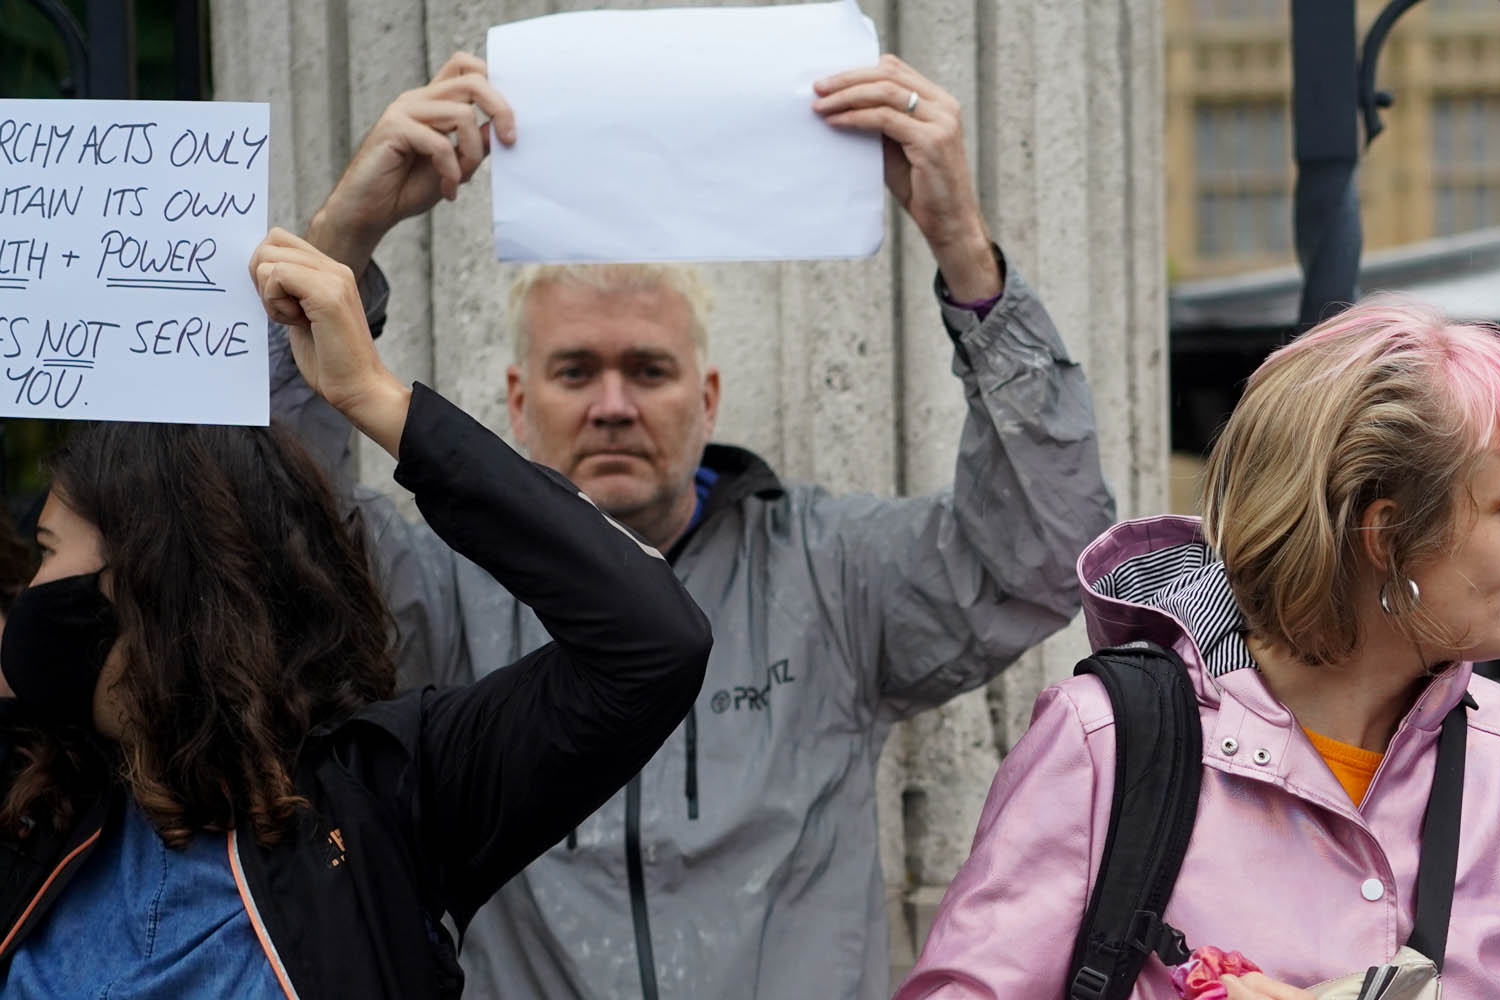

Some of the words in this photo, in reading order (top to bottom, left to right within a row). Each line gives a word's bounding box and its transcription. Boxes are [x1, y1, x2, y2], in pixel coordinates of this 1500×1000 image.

[79, 123, 157, 165] ACTS
[171, 128, 267, 169] ONLY
[104, 188, 147, 216] ITS
[164, 190, 255, 221] OWN
[62, 251, 79, 267] +
[97, 231, 217, 284] POWER
[36, 320, 120, 358] NOT
[130, 317, 248, 356] SERVE
[7, 366, 89, 409] YOU.
